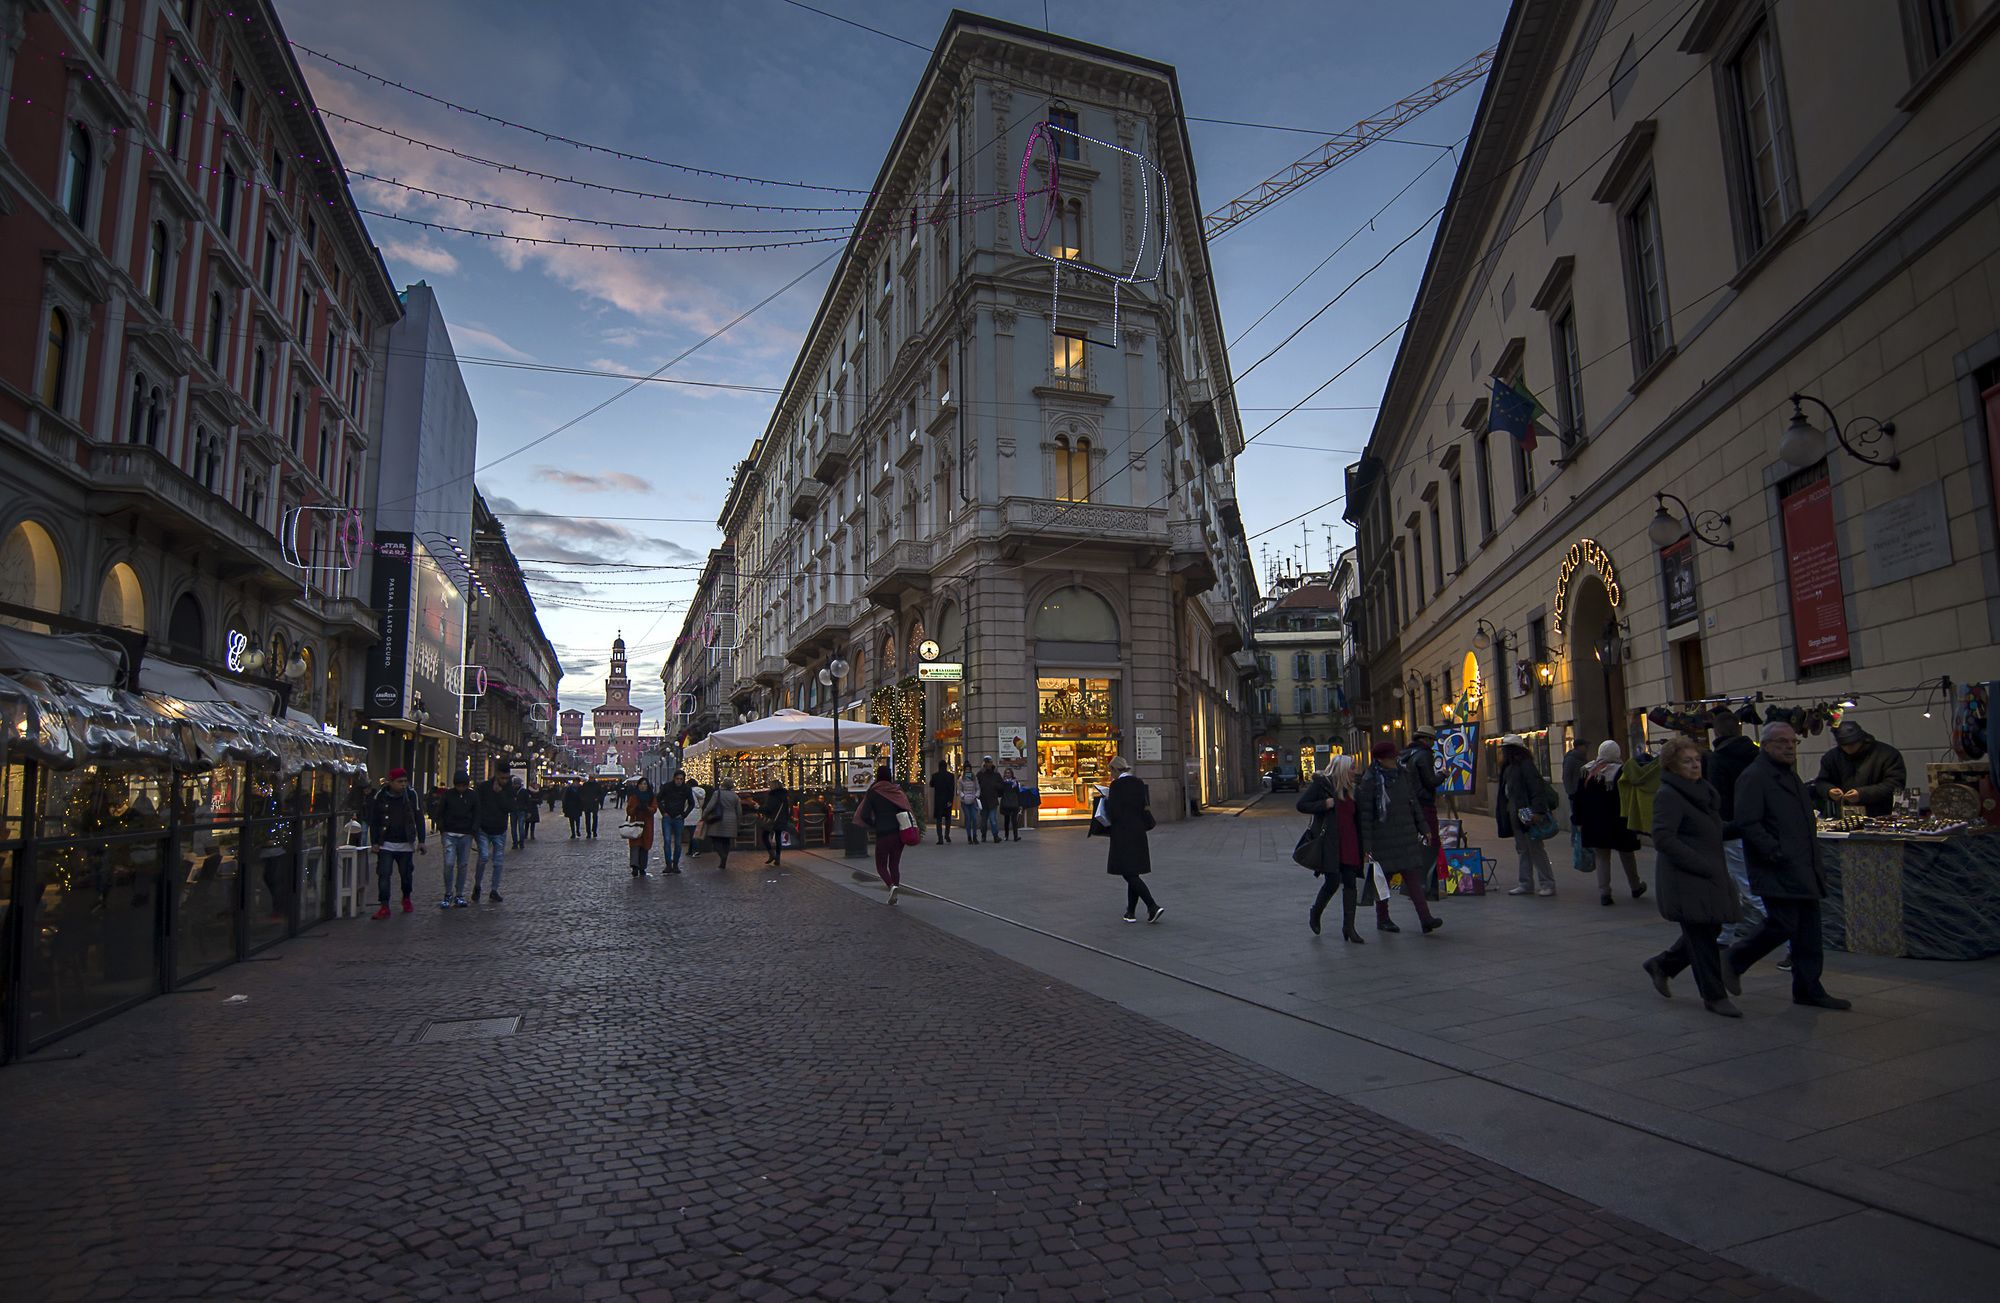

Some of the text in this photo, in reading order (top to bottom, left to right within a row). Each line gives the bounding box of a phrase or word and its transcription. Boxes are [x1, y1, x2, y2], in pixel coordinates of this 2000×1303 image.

[1554, 538, 1619, 634] PICCOLO TEATRO
[387, 603, 393, 612] AL
[384, 636, 392, 668] OSCURO.
